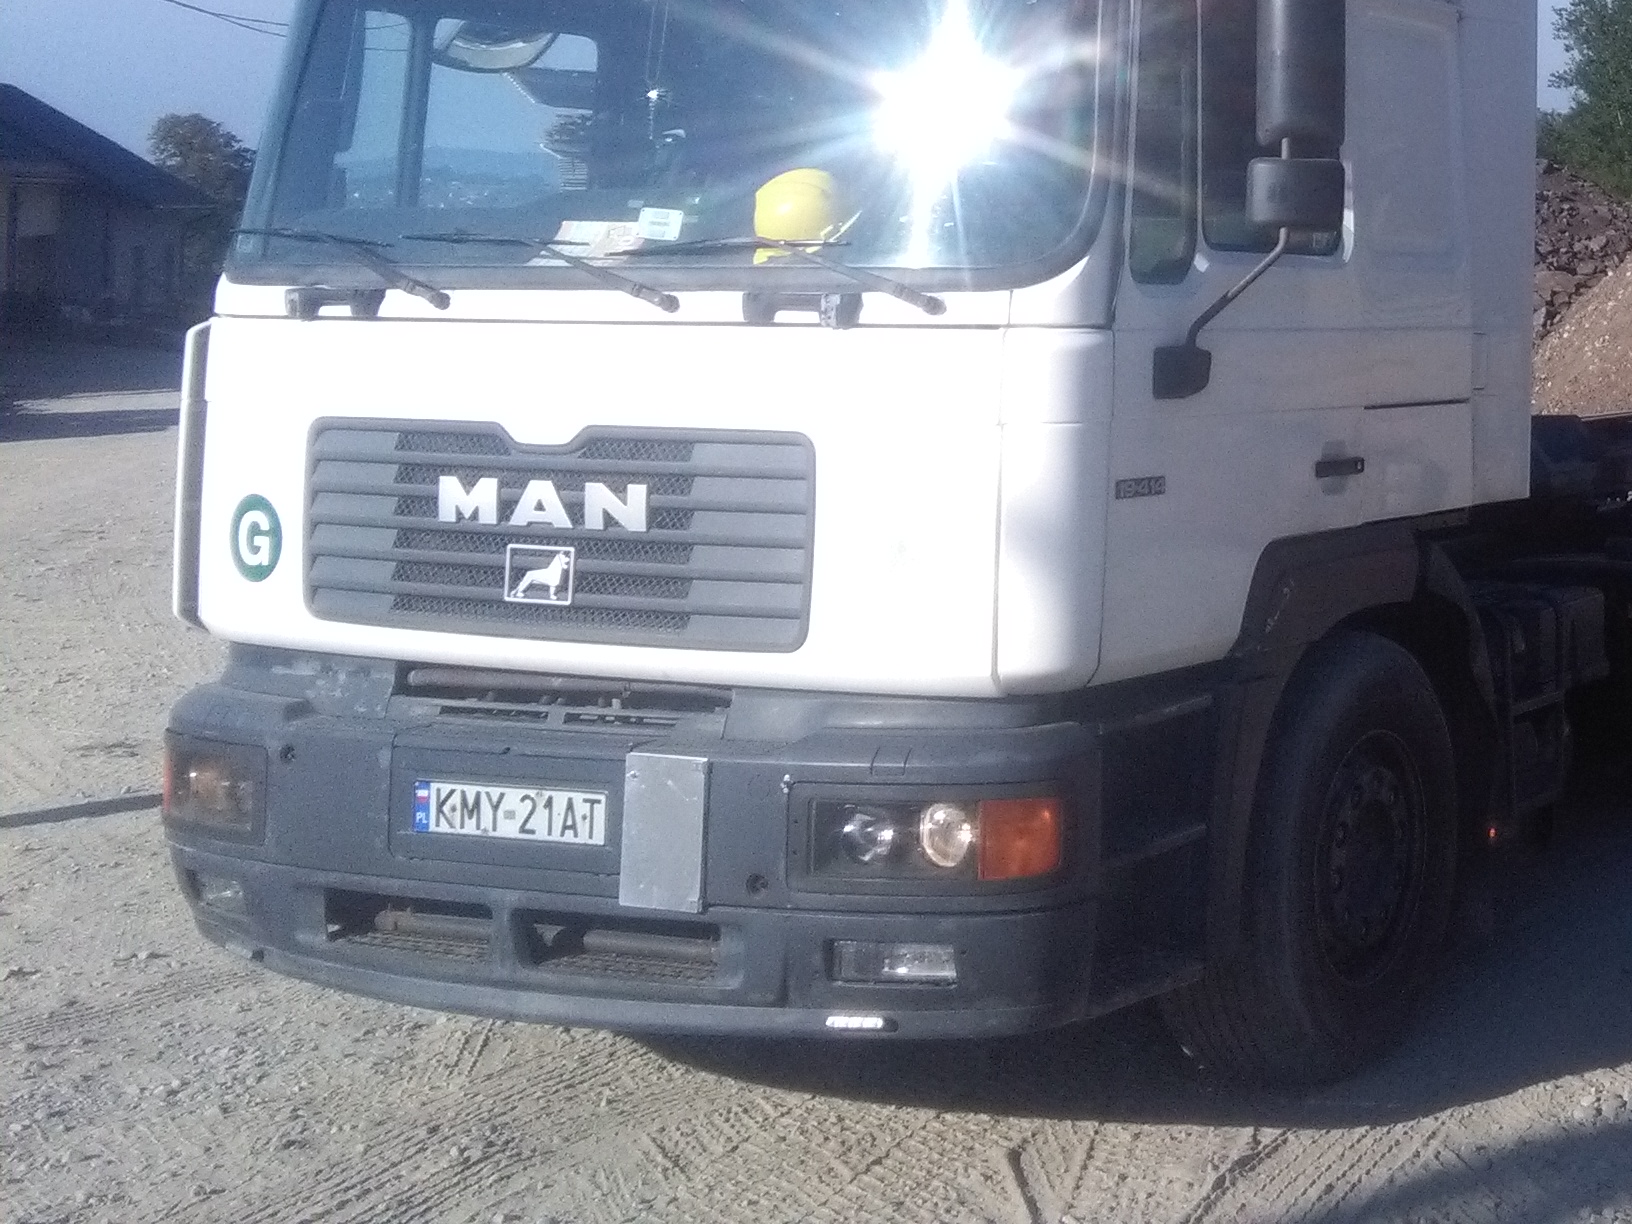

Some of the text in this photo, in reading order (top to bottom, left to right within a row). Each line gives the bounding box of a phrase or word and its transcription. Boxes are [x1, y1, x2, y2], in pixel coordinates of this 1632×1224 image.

[438, 475, 648, 532] MAN
[237, 509, 271, 567] G
[416, 811, 428, 824] PL
